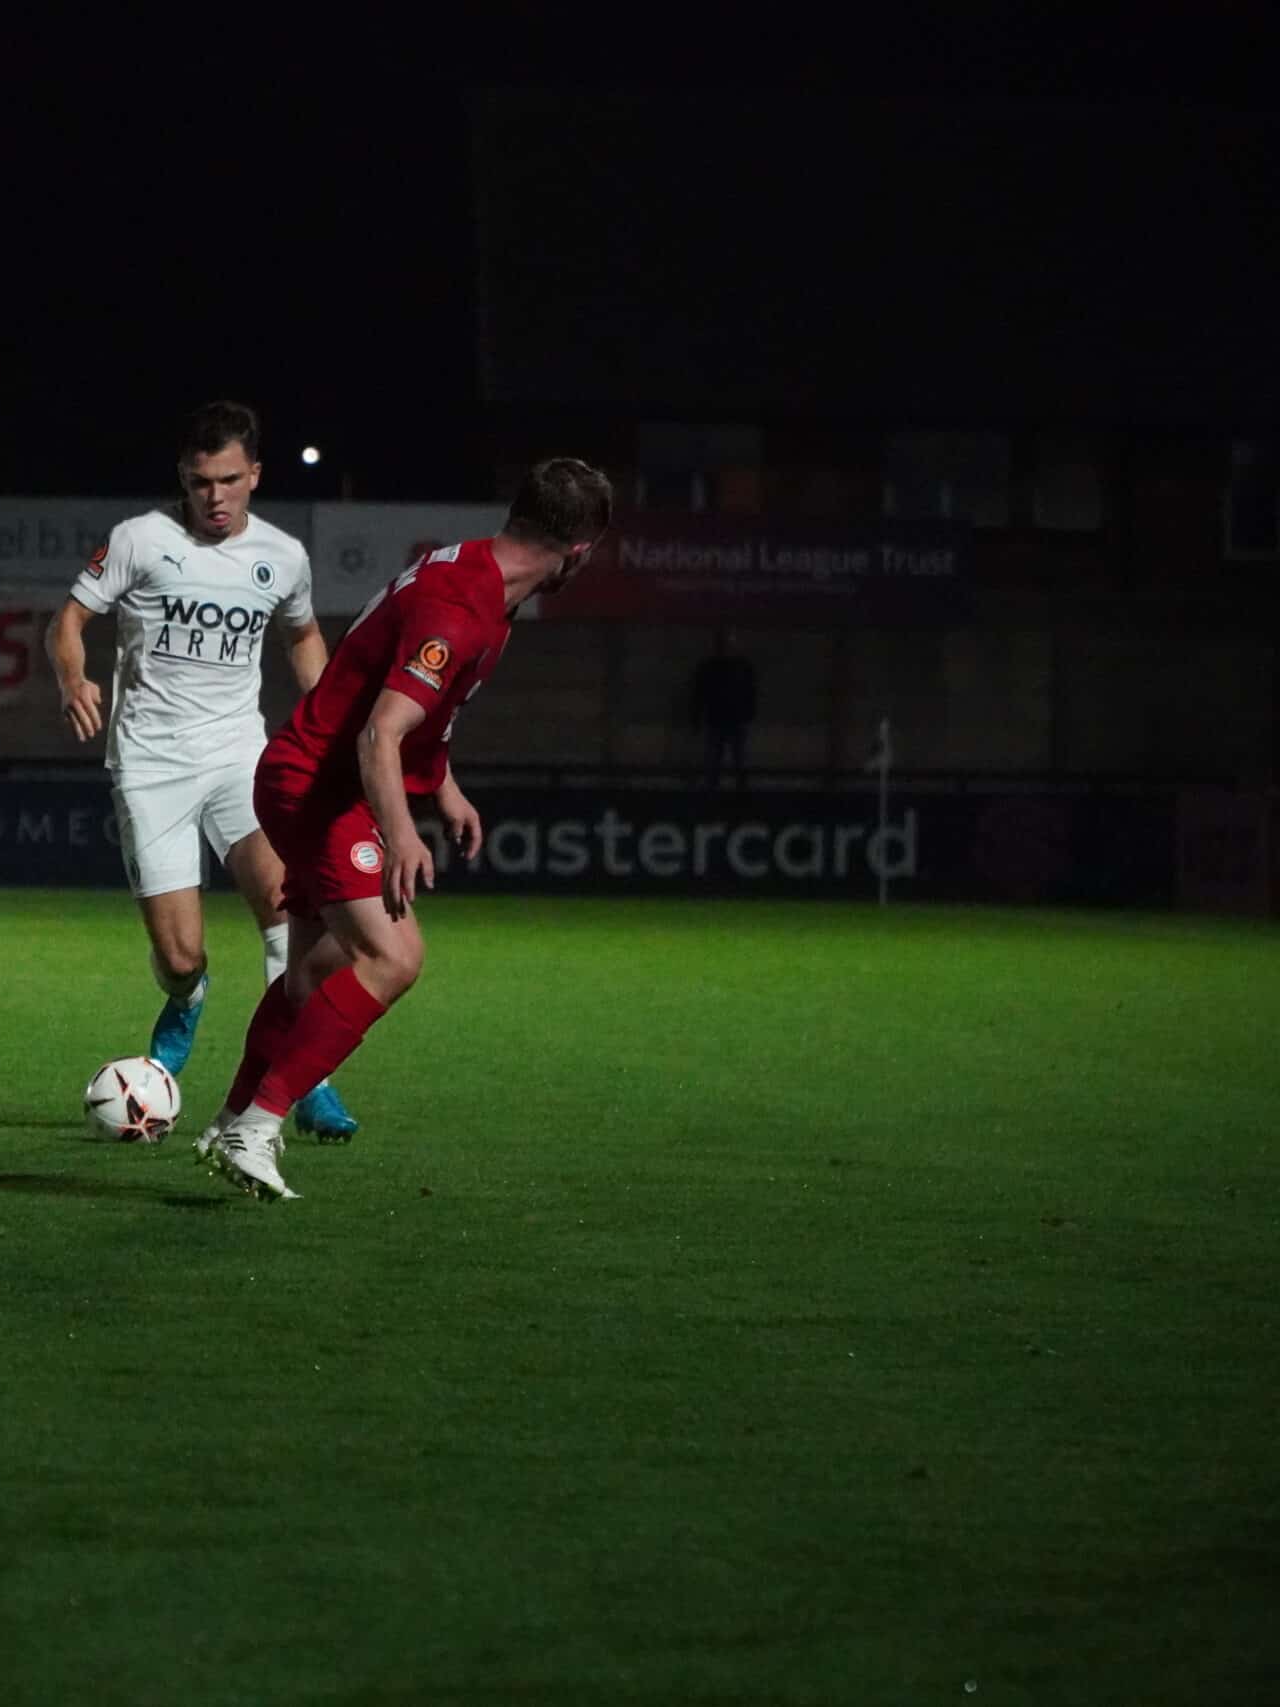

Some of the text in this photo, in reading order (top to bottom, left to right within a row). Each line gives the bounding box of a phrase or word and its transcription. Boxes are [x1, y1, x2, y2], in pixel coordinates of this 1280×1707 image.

[618, 538, 956, 581] National League Trust
[161, 595, 265, 635] WOOD
[418, 807, 917, 879] mastercard
